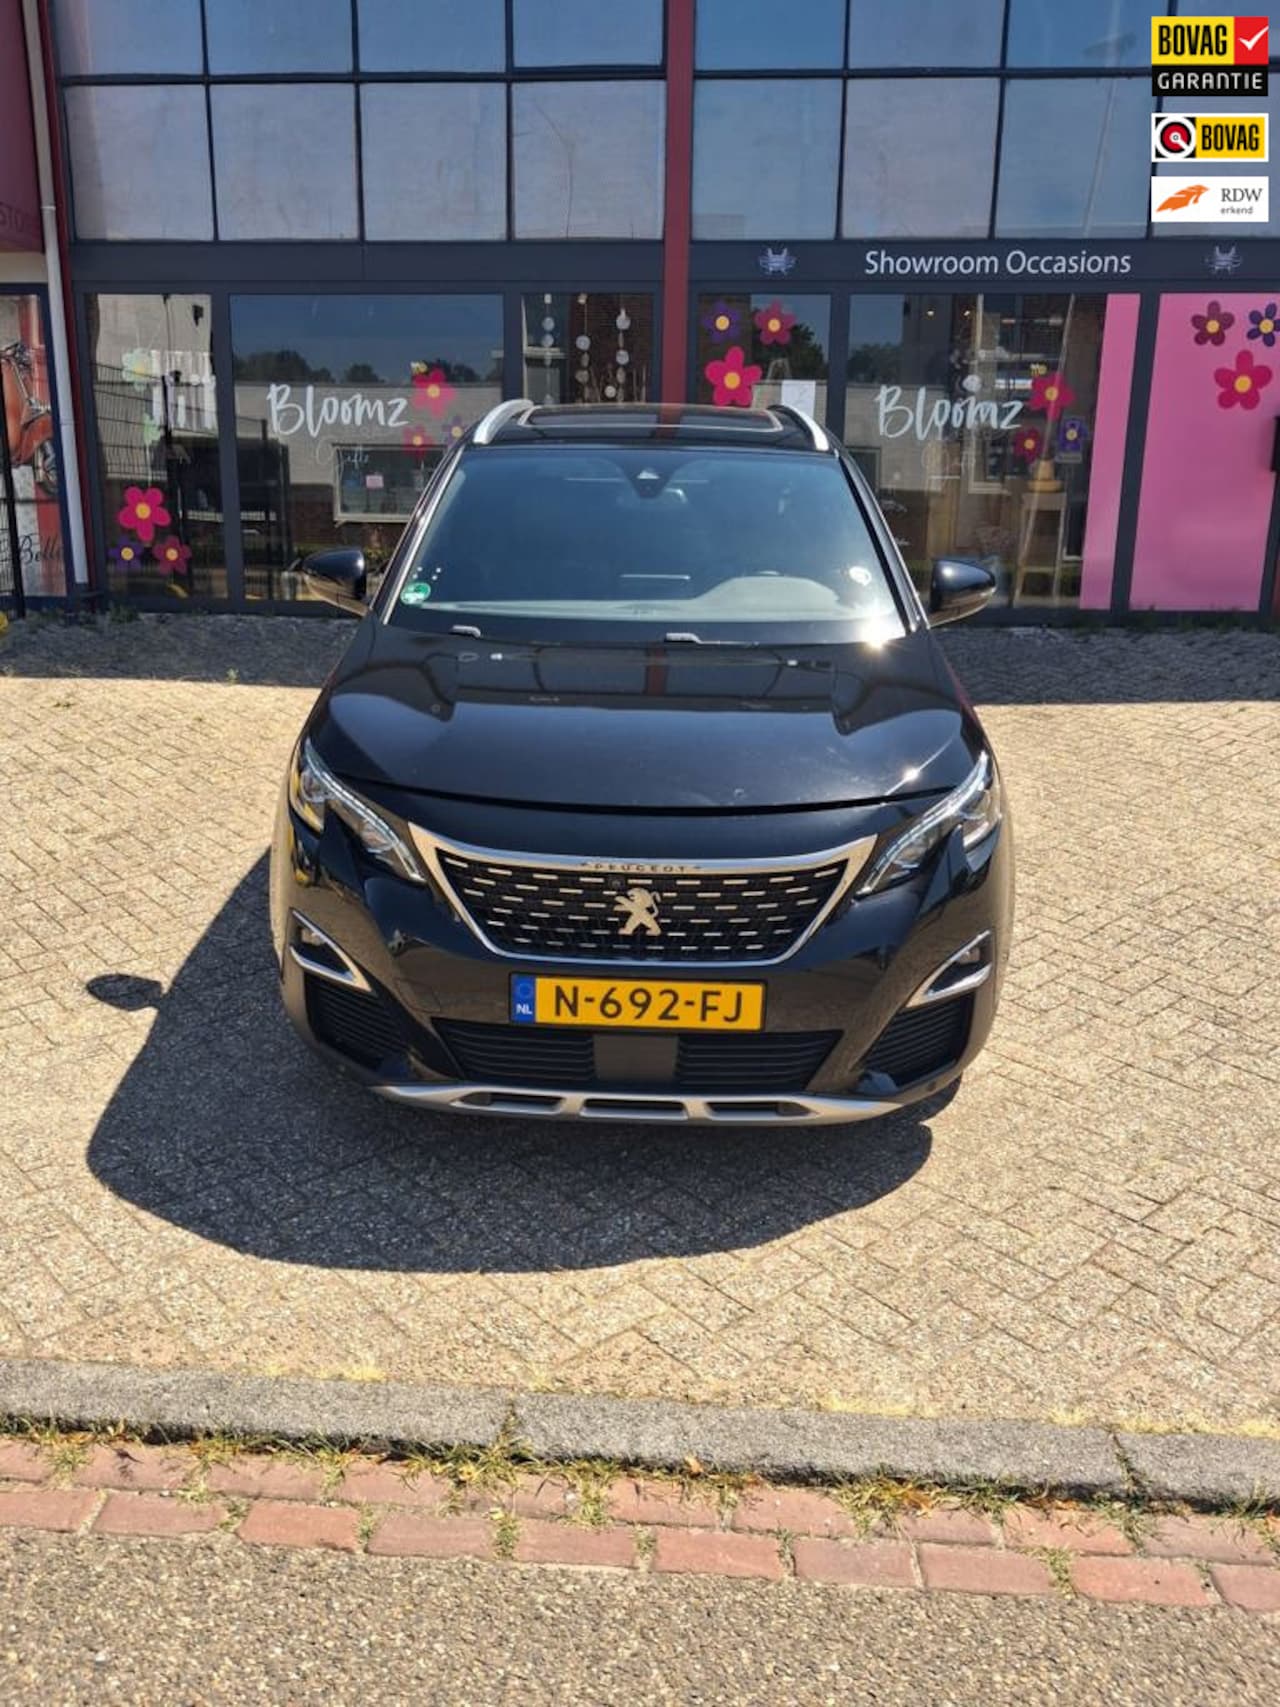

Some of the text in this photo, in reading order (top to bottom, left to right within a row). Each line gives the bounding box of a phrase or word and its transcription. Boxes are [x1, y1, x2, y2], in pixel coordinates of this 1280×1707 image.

[865, 250, 1132, 275] Showroom Occasions
[266, 382, 410, 438] Bloomz
[873, 384, 1024, 441] Bloomz
[594, 862, 687, 873] PEUGEOT
[516, 1003, 534, 1015] NL
[554, 984, 743, 1023] N-692-FJ
